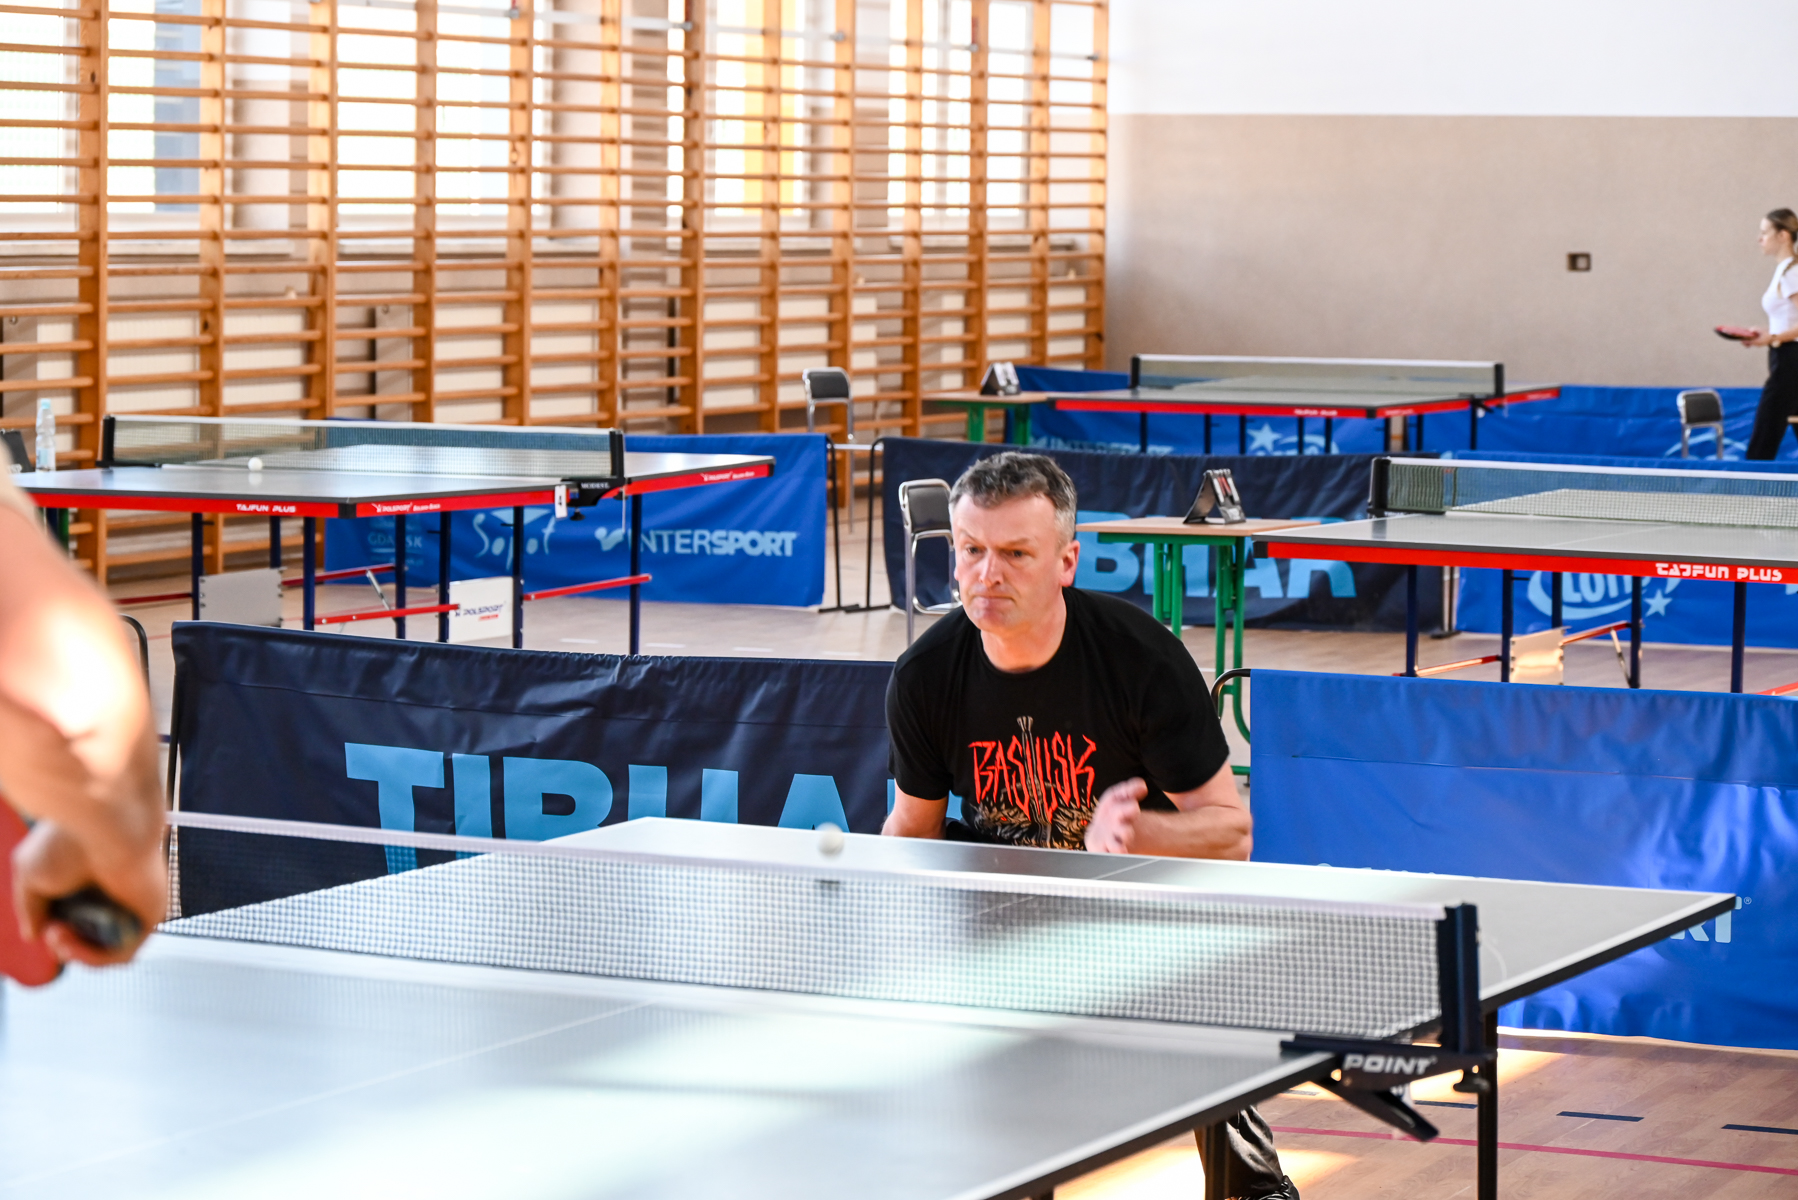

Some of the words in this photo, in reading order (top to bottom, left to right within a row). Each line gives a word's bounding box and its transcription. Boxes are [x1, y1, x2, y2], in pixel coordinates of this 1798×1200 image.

[272, 504, 296, 513] PLUS
[367, 531, 422, 547] GDASK
[627, 529, 797, 557] INTERSPORT
[1655, 562, 1730, 579] TAJFUN
[1736, 570, 1783, 583] PLUS
[1342, 1053, 1432, 1076] POINT
